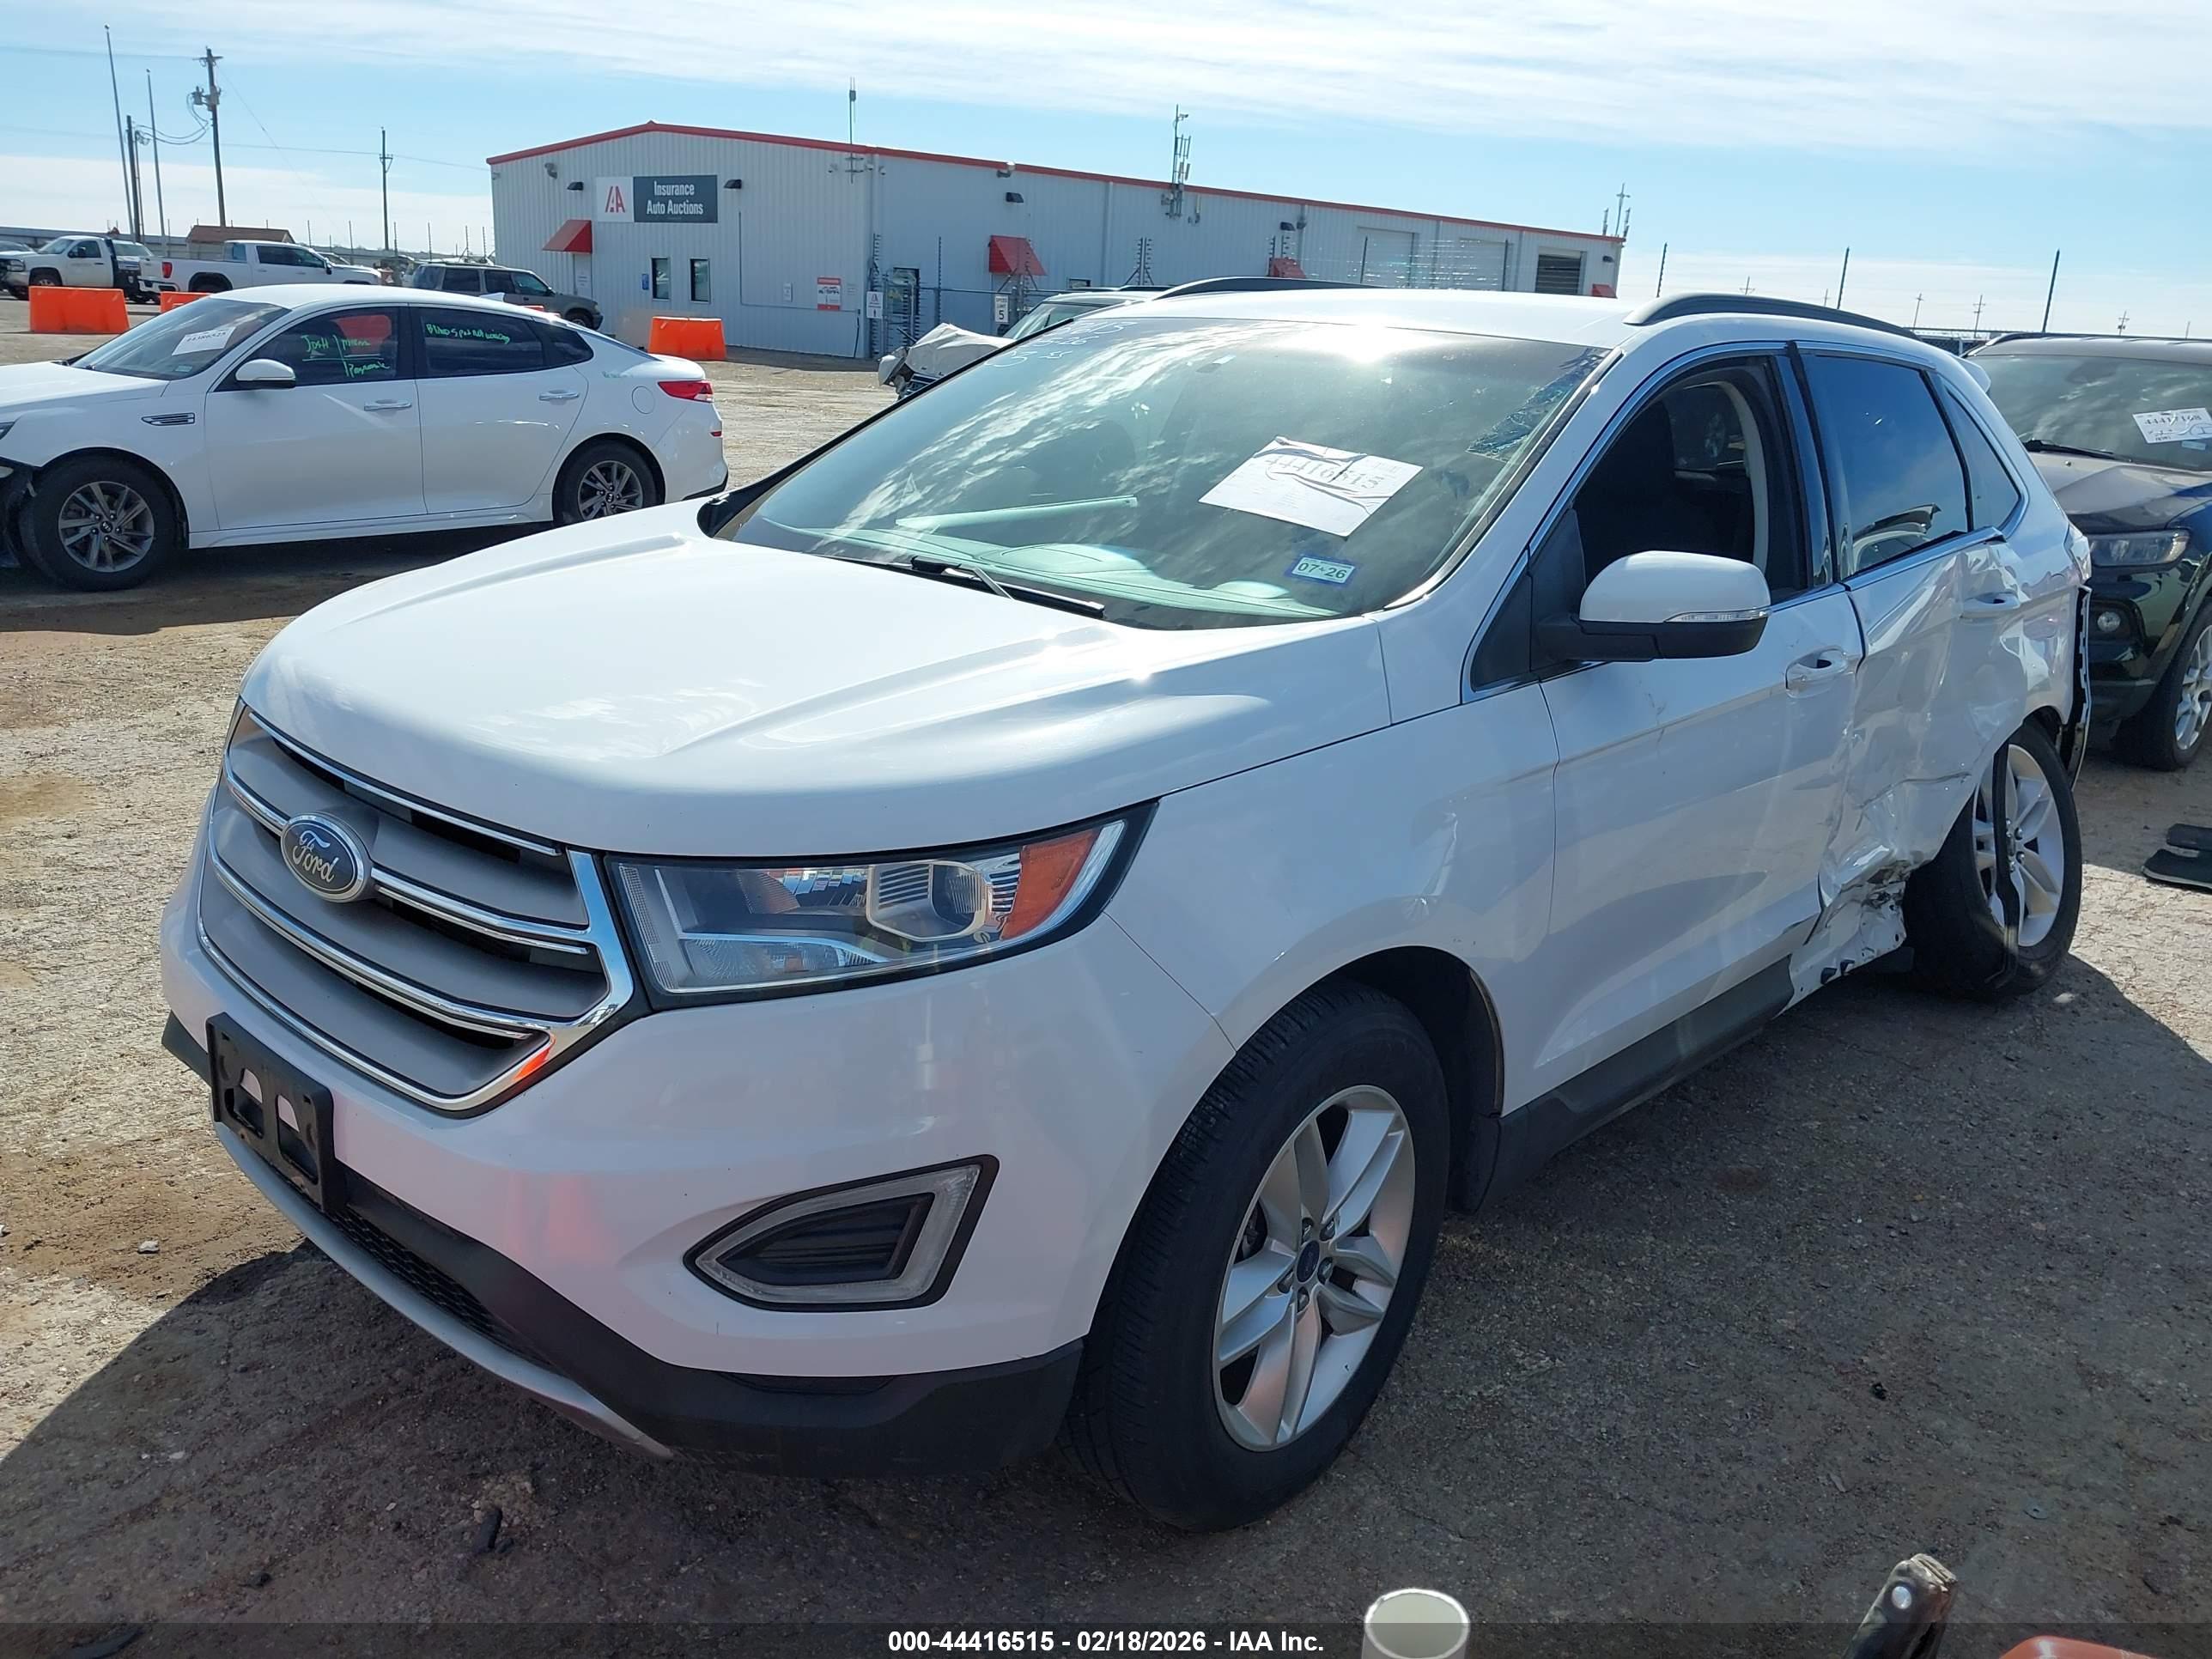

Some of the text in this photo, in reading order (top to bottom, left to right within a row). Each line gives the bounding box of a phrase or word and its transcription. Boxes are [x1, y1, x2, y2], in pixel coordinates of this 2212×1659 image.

[653, 180, 695, 196] Insurance
[647, 199, 704, 215] Auto Auctions
[999, 310, 1005, 319] 5
[1297, 562, 1320, 573] 07
[1324, 567, 1347, 579] 26
[292, 830, 331, 883] Ford
